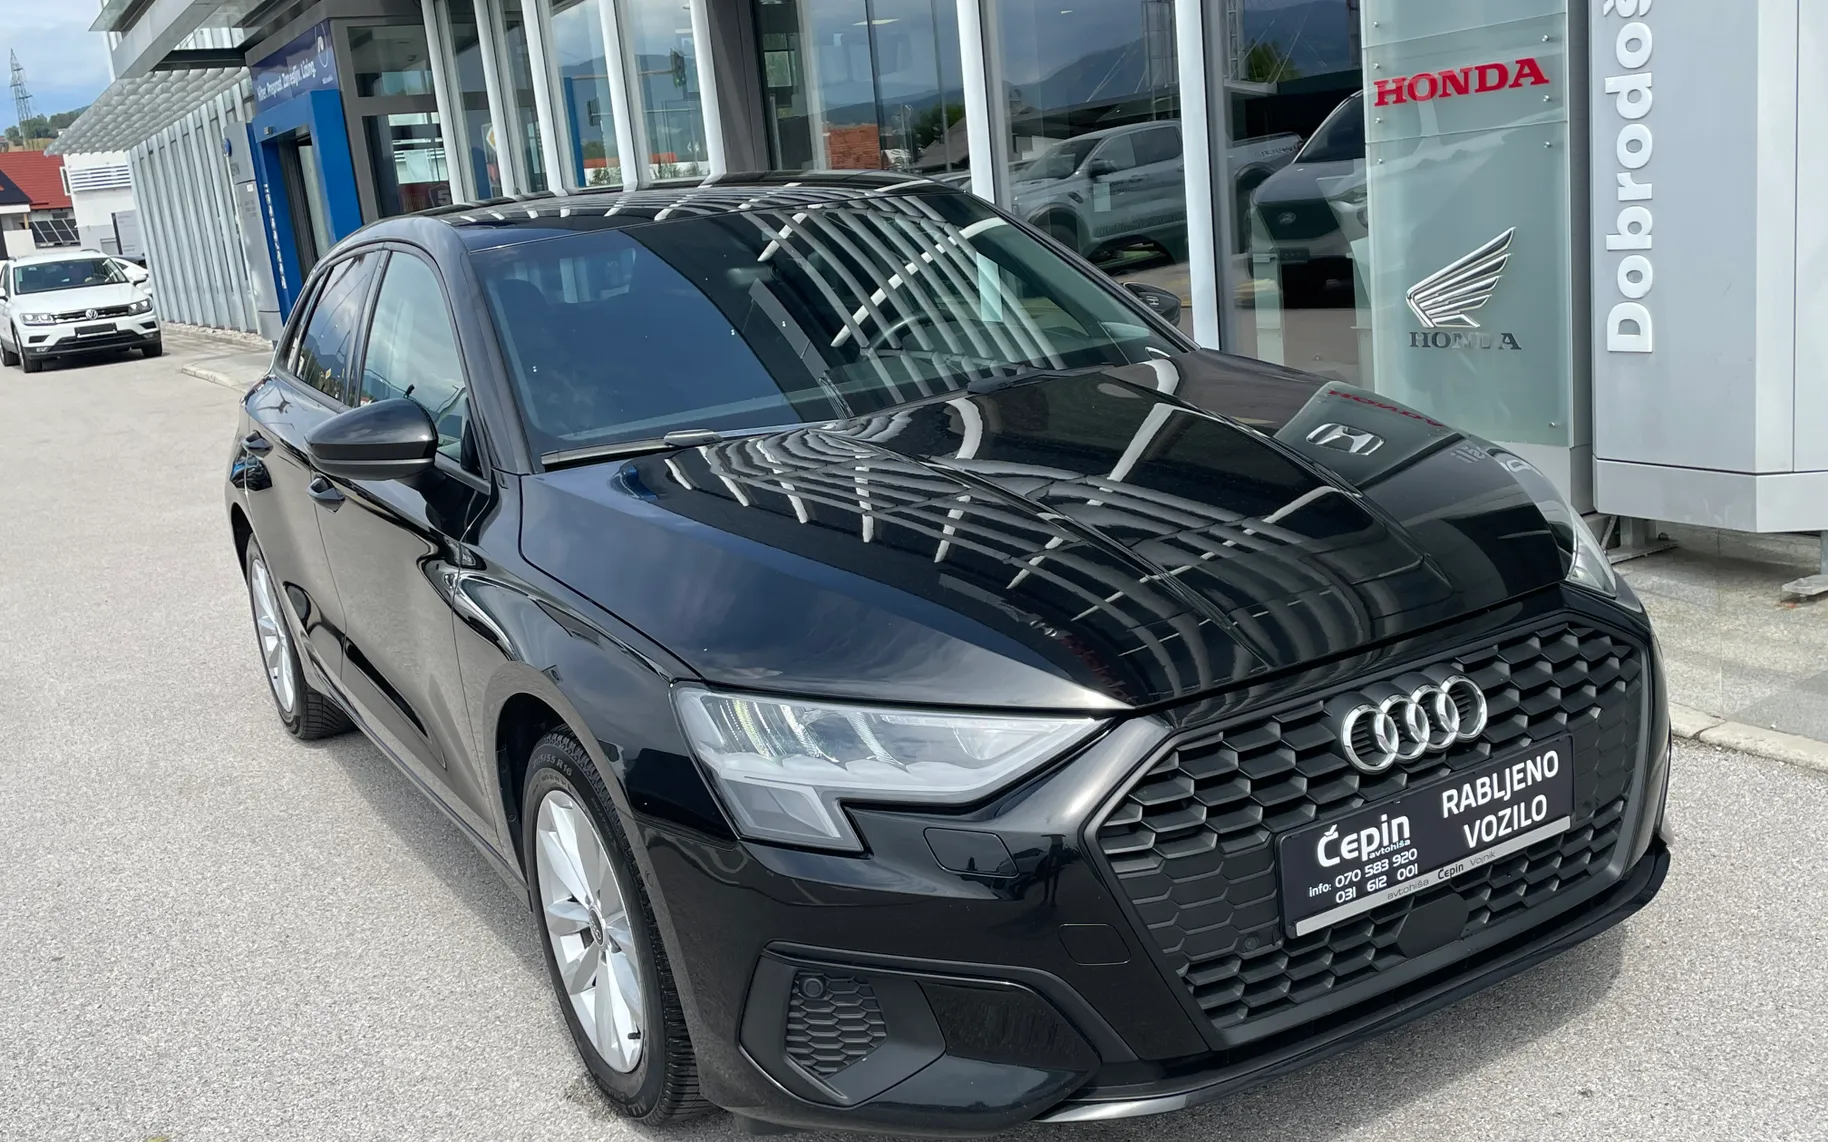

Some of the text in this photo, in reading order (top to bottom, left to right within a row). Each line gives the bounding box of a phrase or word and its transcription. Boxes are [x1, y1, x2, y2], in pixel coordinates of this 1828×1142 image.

[1374, 57, 1549, 107] HONDA
[1409, 331, 1522, 350] HONDA
[1441, 749, 1560, 818] RABLJENO
[1316, 813, 1411, 868] Čepin
[1463, 793, 1548, 849] VOZILO
[1335, 869, 1362, 888] 070
[1364, 858, 1389, 878] 583
[1392, 848, 1418, 868] 920
[1368, 838, 1411, 859] avtohiša
[1335, 863, 1418, 904] 031 612 001
[1387, 878, 1430, 900] avtohiša
